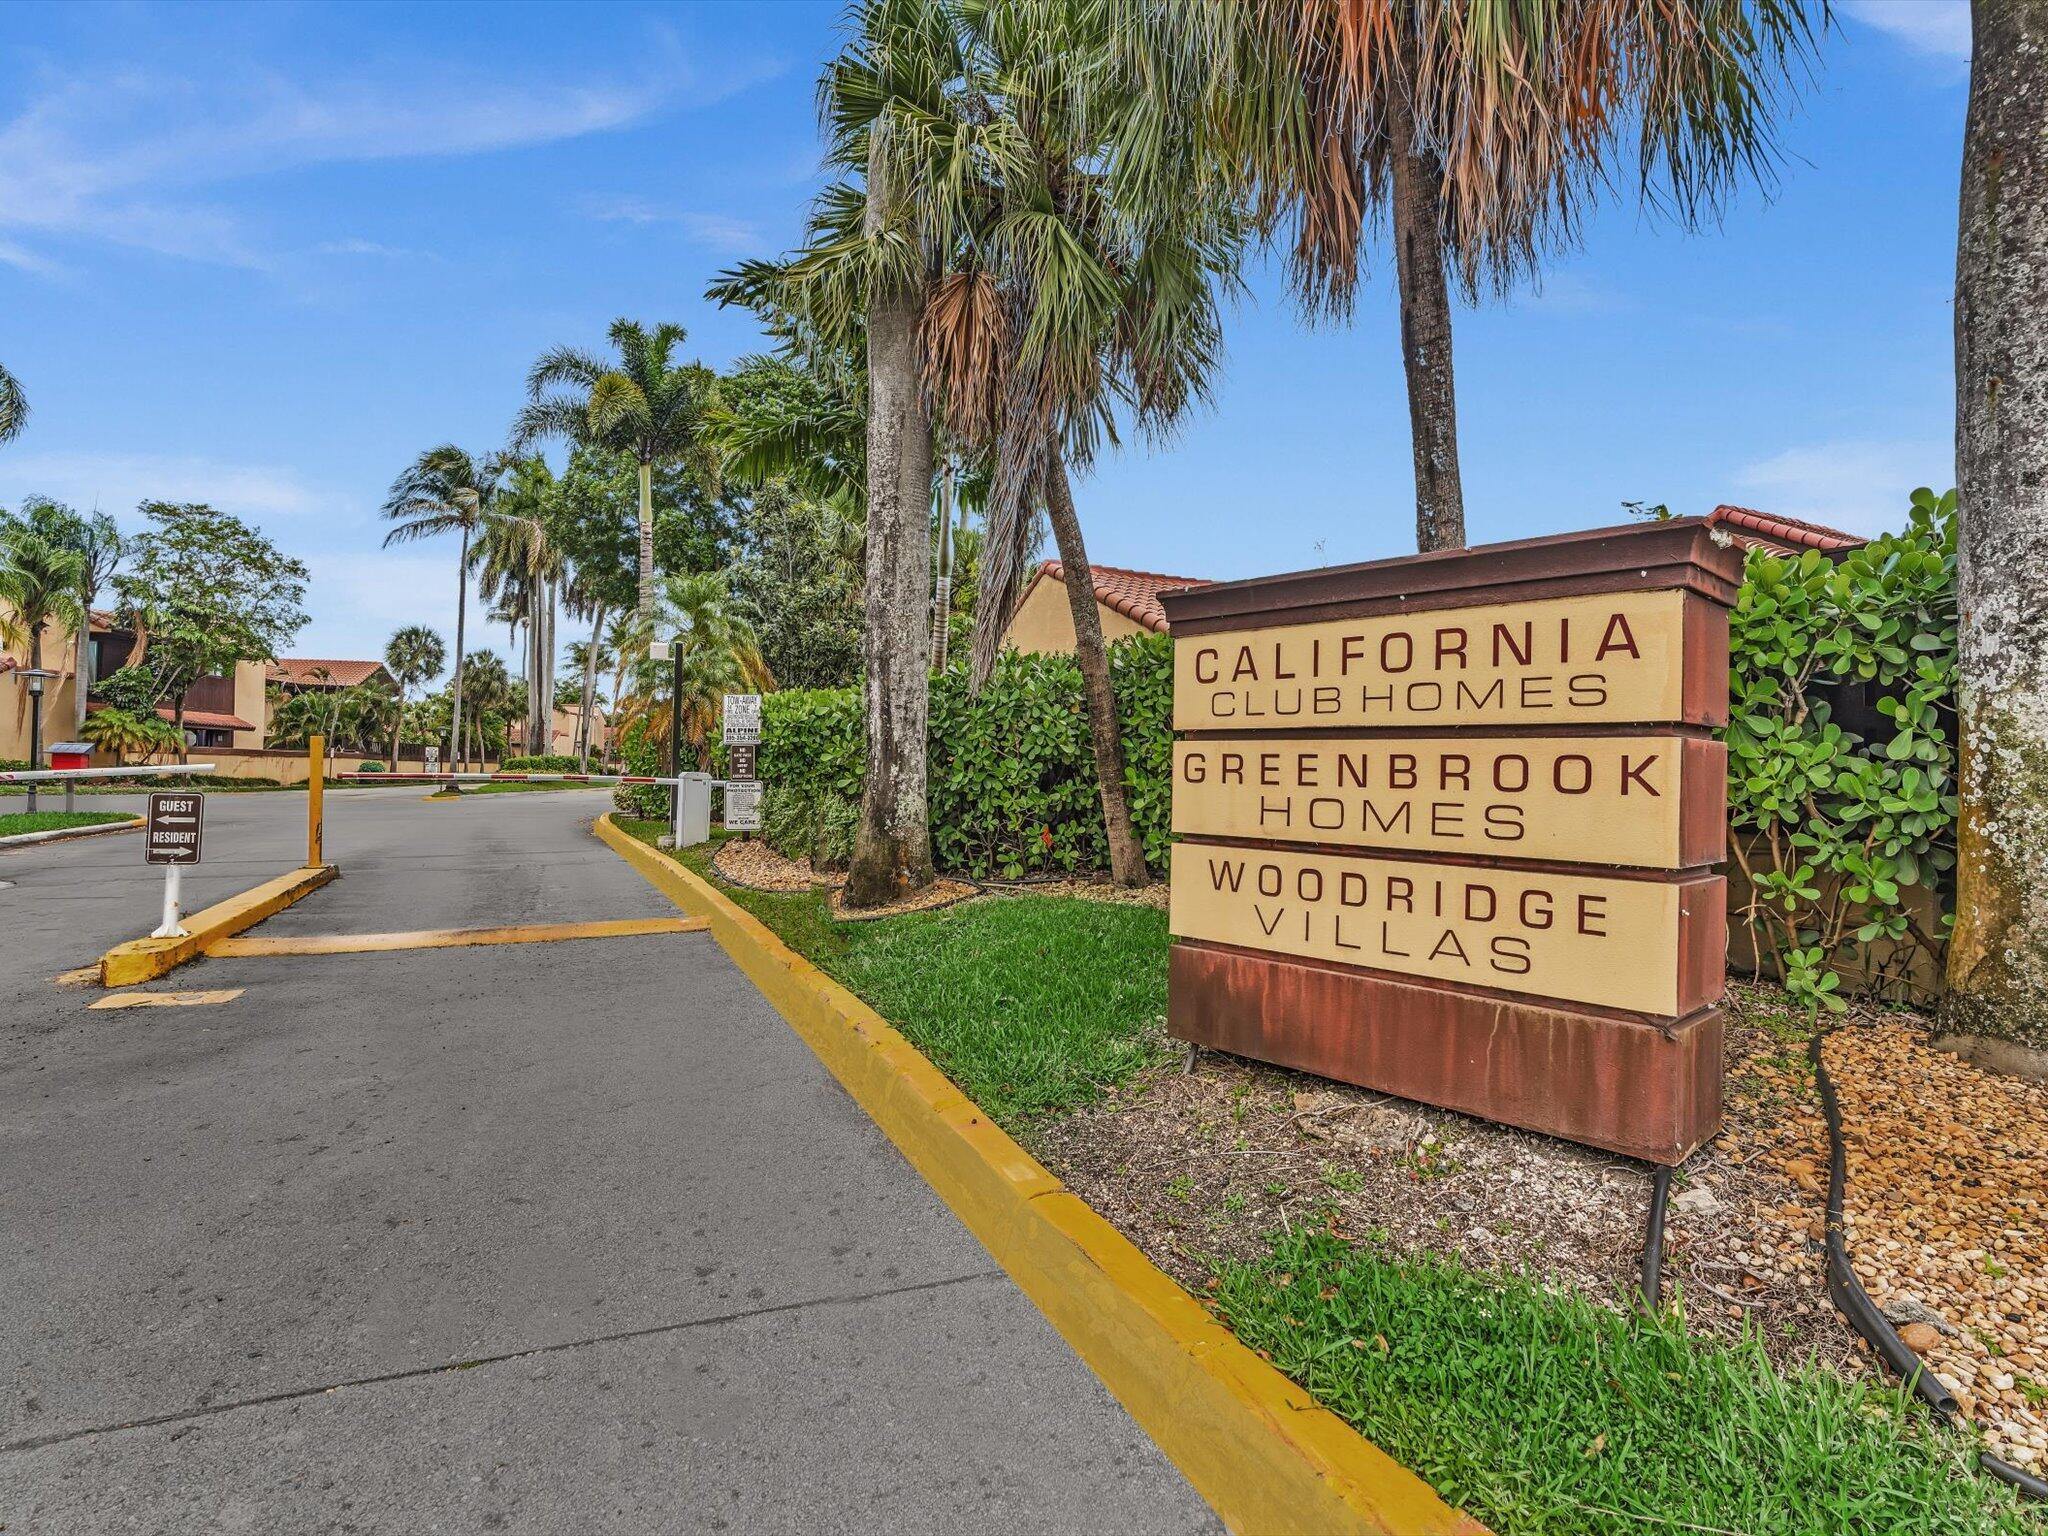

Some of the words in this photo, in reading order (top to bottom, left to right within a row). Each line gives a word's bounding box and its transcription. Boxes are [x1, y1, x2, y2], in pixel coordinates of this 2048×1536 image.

[1195, 613, 1640, 685] CALIFORNIA
[734, 705, 751, 714] ZONE
[1211, 686, 1341, 718] CLUB
[1362, 674, 1608, 713] HOMES
[1183, 752, 1661, 797] GREENBROOK
[159, 800, 194, 812] GUEST
[1260, 796, 1525, 841] HOMES
[152, 831, 197, 844] RESIDENT
[1208, 859, 1607, 938] WOODRIDGE
[1254, 904, 1532, 974] VILLAS
